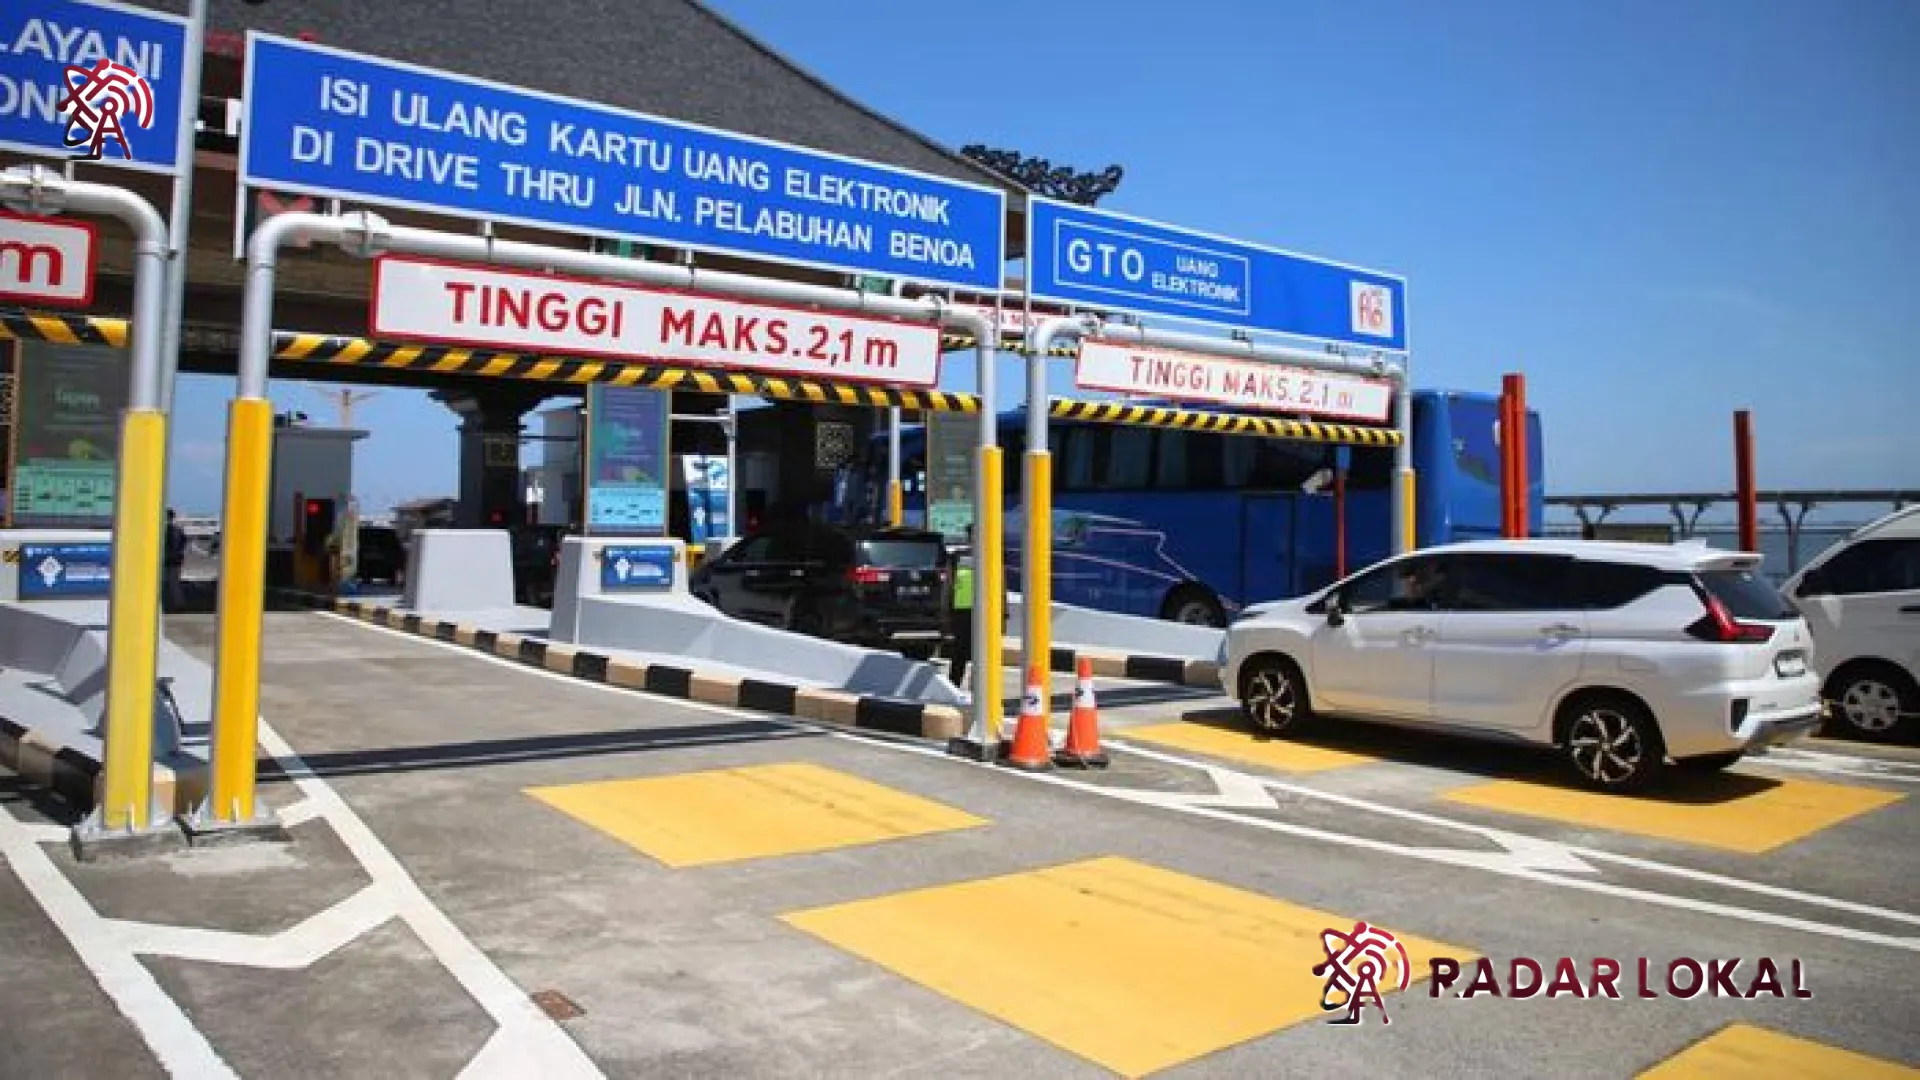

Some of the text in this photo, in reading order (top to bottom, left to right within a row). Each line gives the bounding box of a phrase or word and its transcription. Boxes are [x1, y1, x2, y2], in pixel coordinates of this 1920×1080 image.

[322, 76, 949, 223] ISI ULANG KARTU UANG ELEKTRONIK
[293, 126, 974, 268] DI DRIVE THRU JLN. PELABUHAN BENOA
[1067, 238, 1145, 283] GTO
[445, 281, 624, 337] TINGGI
[864, 337, 898, 366] m
[1130, 355, 1211, 392] TINGGI
